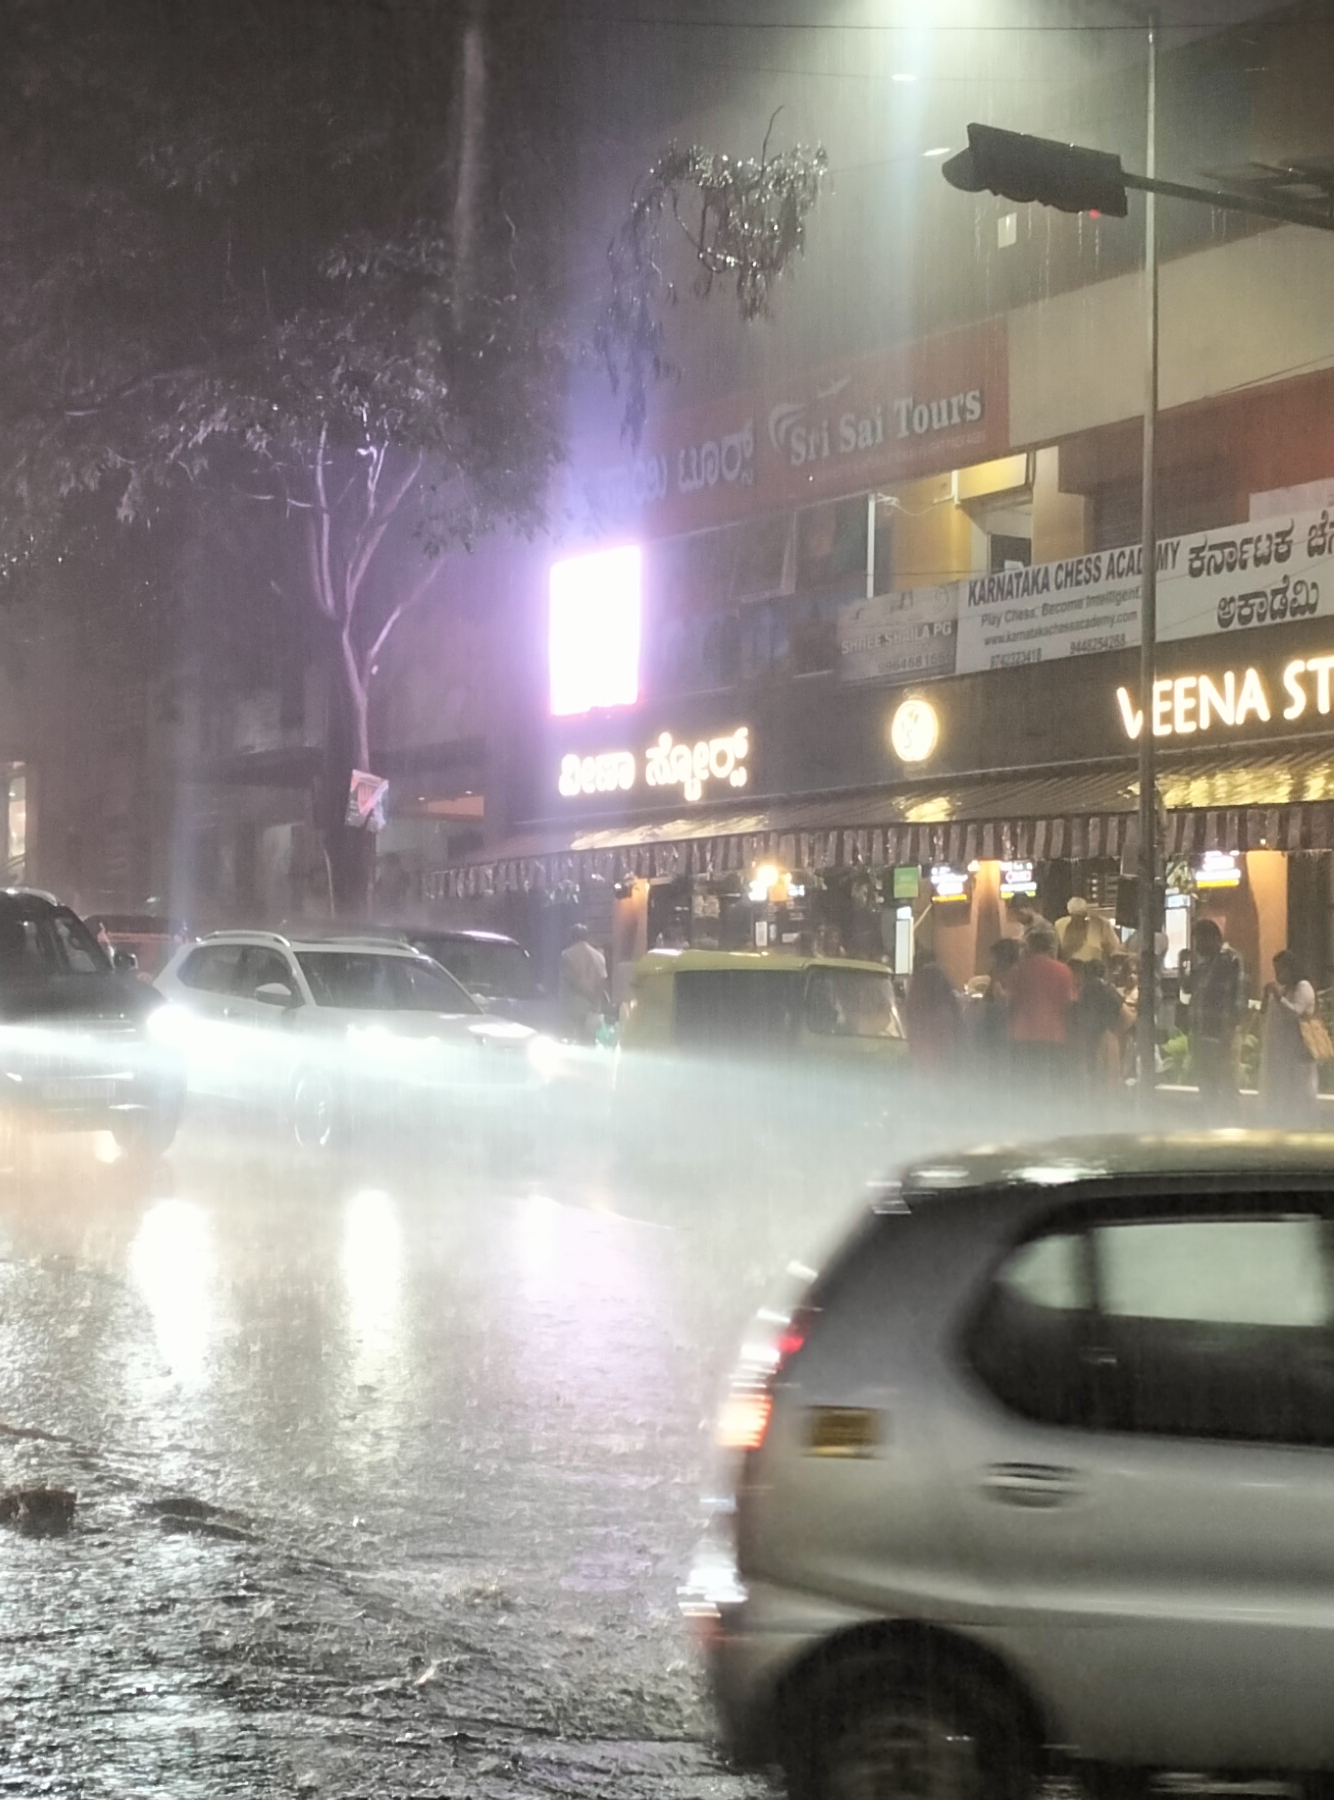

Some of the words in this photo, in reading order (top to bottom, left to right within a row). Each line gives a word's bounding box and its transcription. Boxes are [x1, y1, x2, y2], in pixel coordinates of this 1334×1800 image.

[790, 421, 831, 466] Sri
[838, 406, 884, 454] Sai
[893, 389, 982, 438] Tours
[968, 566, 1049, 607] KARNATAKA
[1054, 554, 1102, 590] CHESS
[1106, 541, 1180, 581] ACADMY
[1188, 518, 1295, 578] ಕರ್ನಾಟಕ
[933, 621, 952, 636] PG
[981, 613, 1001, 628] Play
[1041, 598, 1083, 617] Become
[1086, 587, 1140, 609] Intelligent
[1217, 574, 1320, 628] ಅಕಾಡೆಮಿ
[1117, 667, 1271, 740] VEENA
[559, 752, 635, 796] ವೀಣಾ
